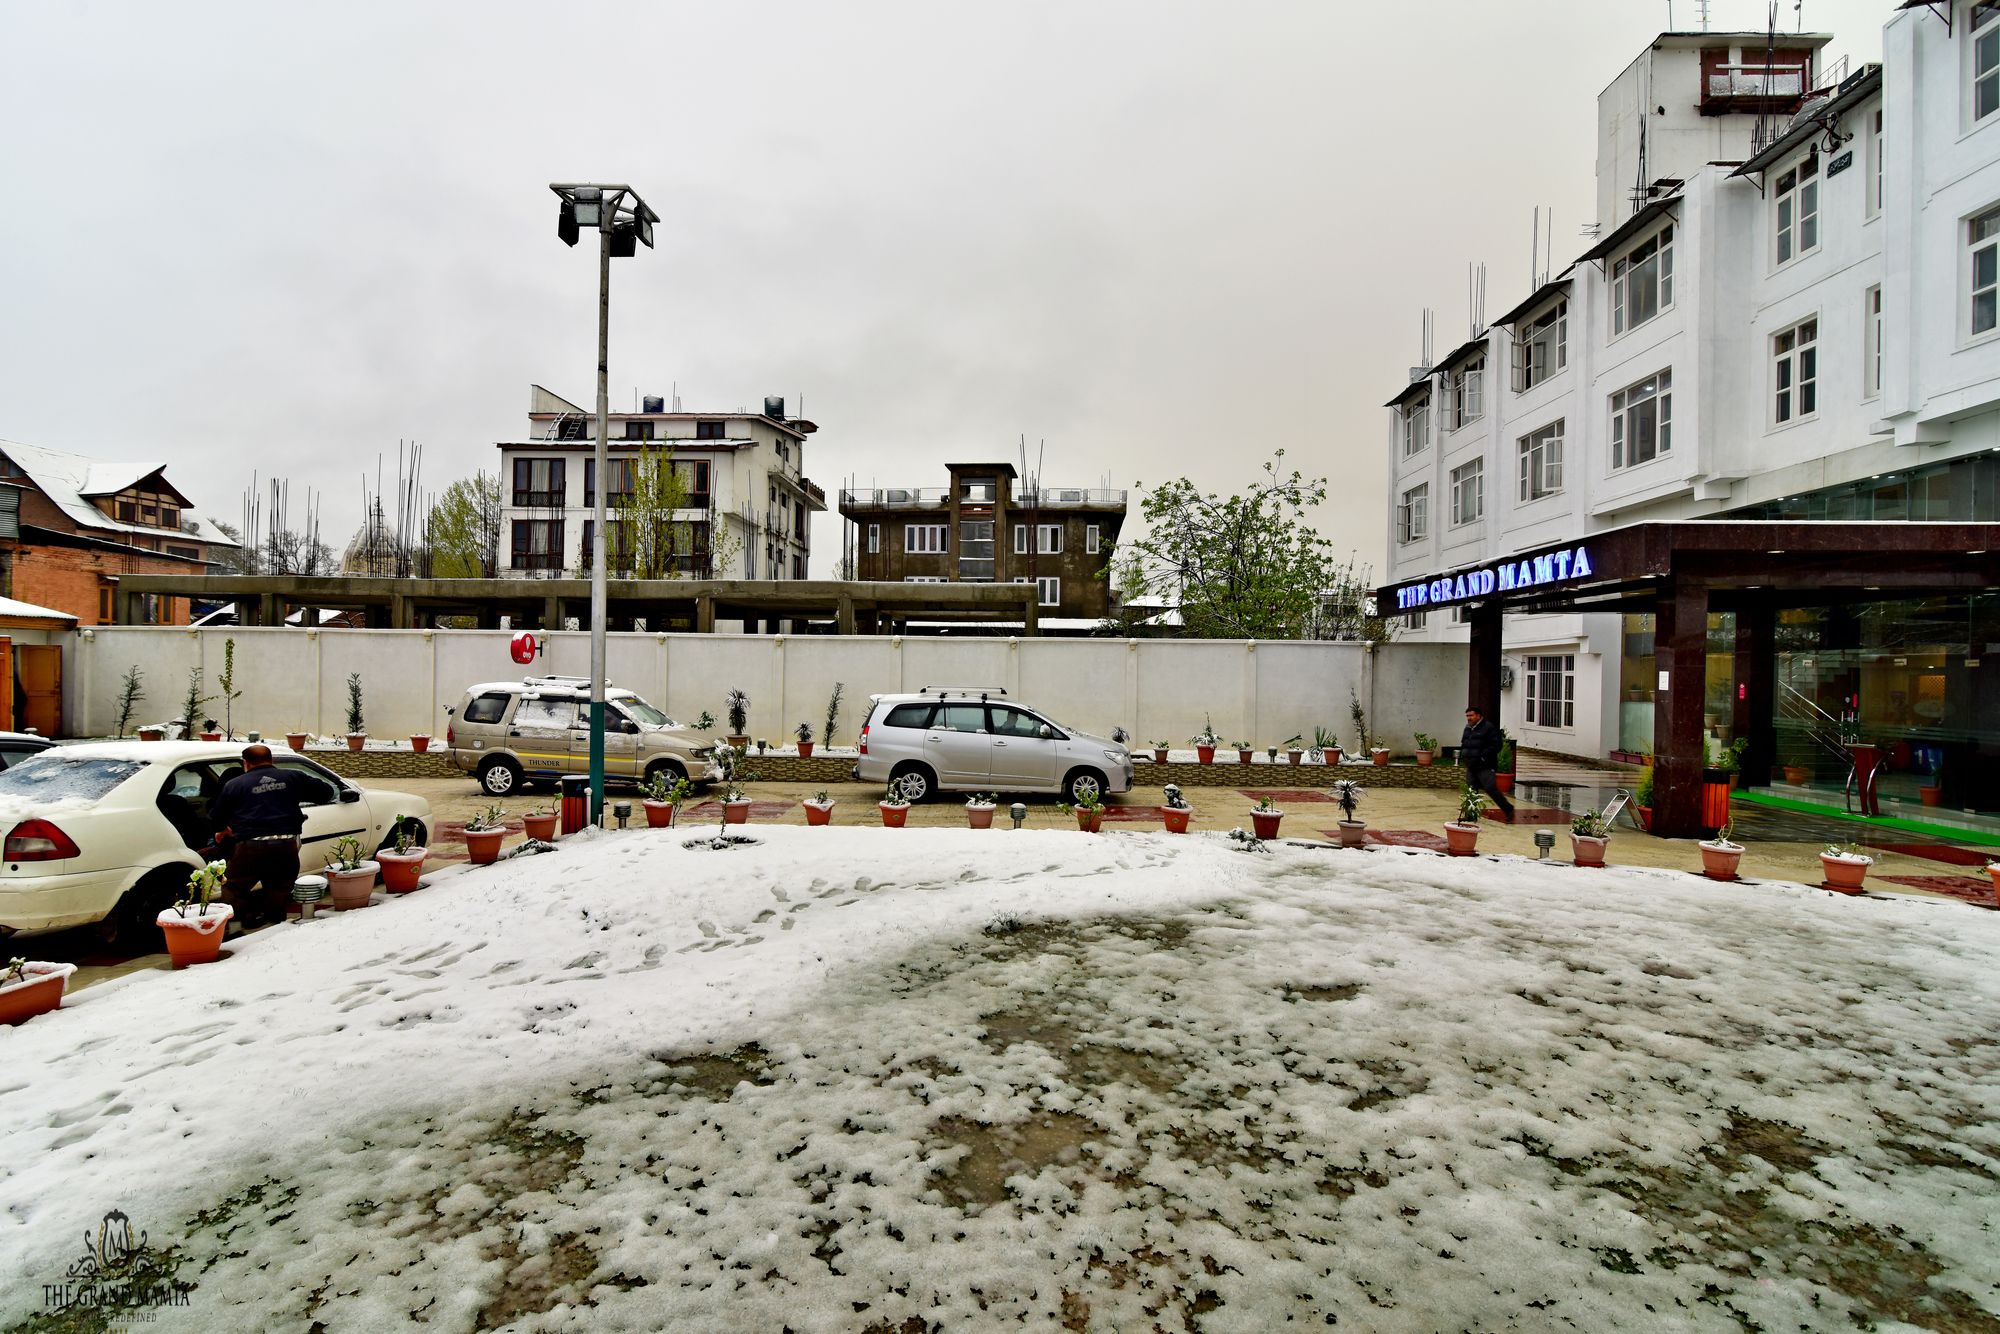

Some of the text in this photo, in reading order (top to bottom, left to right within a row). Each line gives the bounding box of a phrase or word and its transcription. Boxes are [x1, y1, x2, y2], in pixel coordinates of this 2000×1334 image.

[1396, 546, 1592, 609] THE GRAND MAMTA
[529, 759, 560, 767] THUNDER
